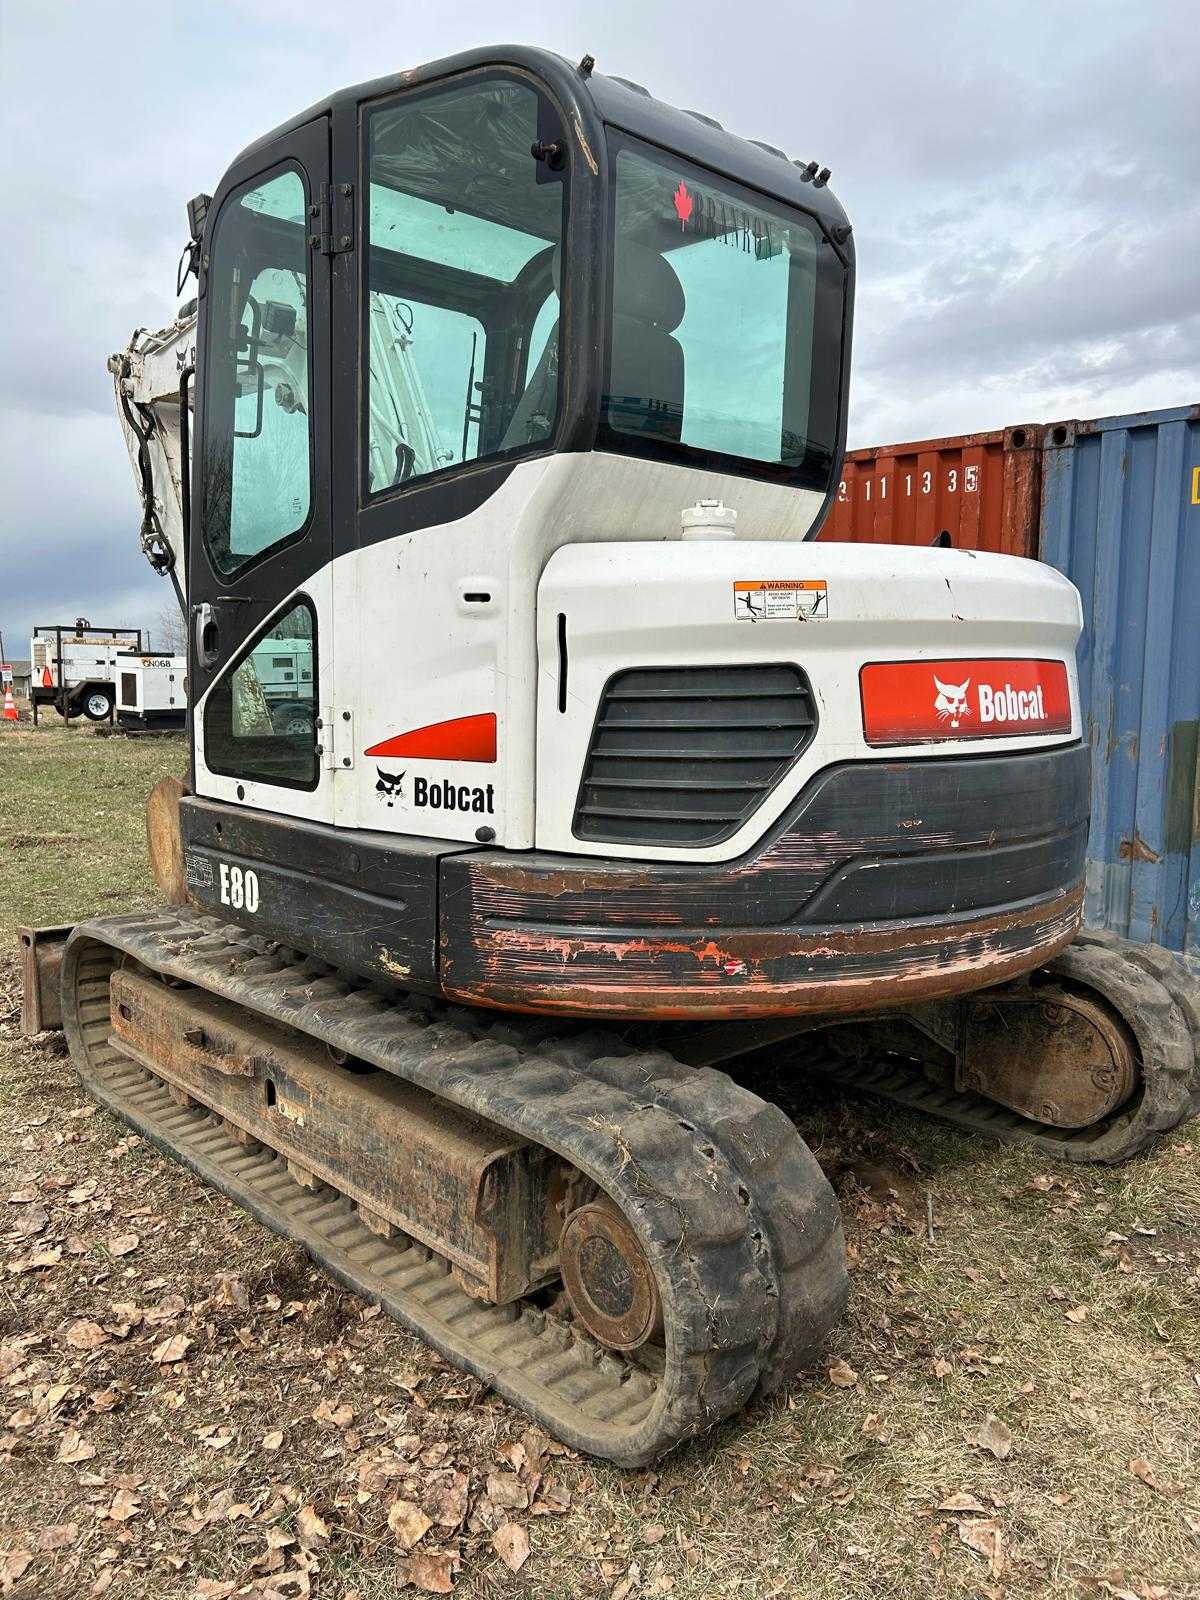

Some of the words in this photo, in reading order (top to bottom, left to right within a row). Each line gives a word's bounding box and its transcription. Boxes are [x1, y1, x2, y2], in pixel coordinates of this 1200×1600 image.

[978, 683, 1046, 722] Bobcat
[414, 777, 494, 814] Bobcat
[220, 863, 259, 913] E80
